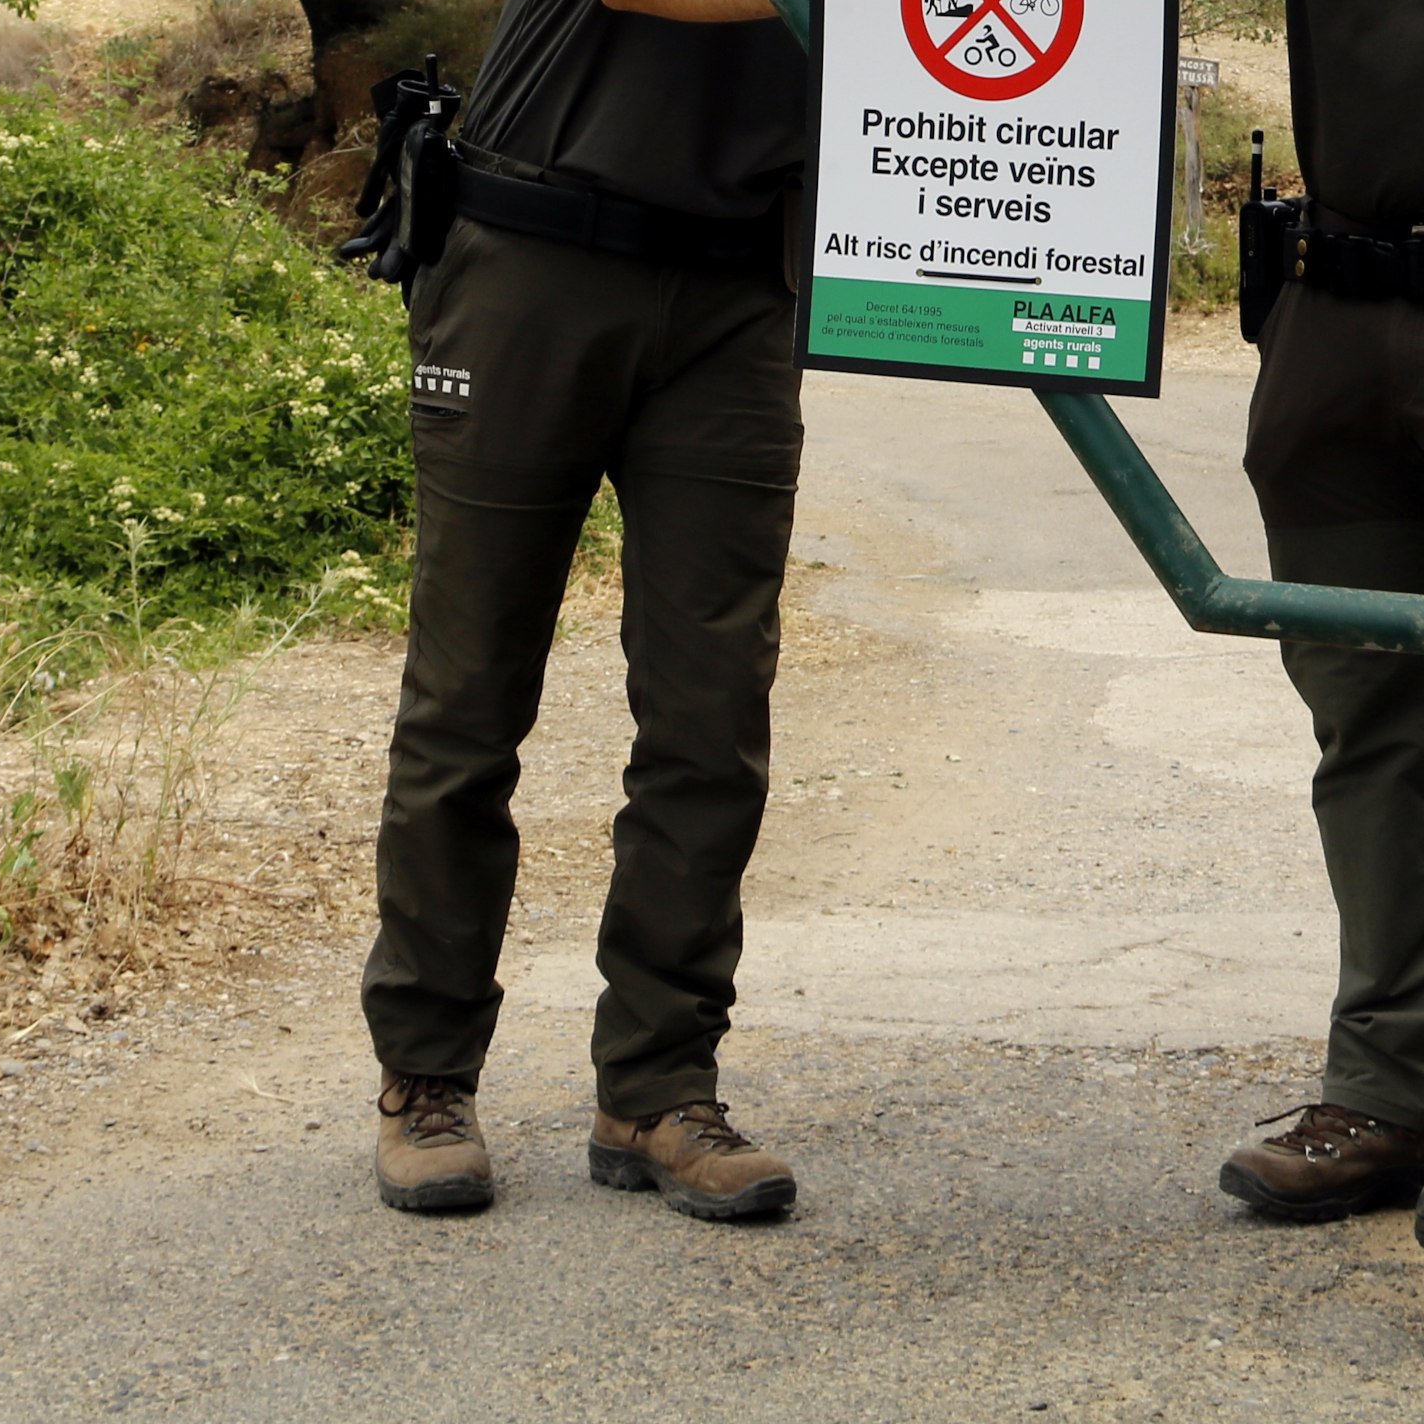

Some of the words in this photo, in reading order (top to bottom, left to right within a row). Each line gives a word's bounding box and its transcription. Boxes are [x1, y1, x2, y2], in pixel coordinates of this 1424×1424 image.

[862, 108, 987, 143] Prohibit
[996, 117, 1120, 150] circular
[871, 147, 999, 187] Excepte
[1008, 156, 1096, 188] veïns
[918, 187, 926, 215] i
[935, 194, 1052, 224] serveis
[824, 232, 859, 257] Alt
[866, 236, 912, 261] risc
[1045, 248, 1145, 277] forestal
[866, 301, 899, 314] Decret
[901, 304, 942, 317] 64/1995
[1013, 300, 1054, 321] PLA
[1059, 304, 1116, 326] ALFA
[827, 312, 842, 323] pel
[845, 314, 866, 325] qual
[936, 322, 980, 334] mesures
[1025, 321, 1062, 333] Activat
[1065, 325, 1094, 335] nivell
[1096, 326, 1103, 336] 3
[821, 326, 834, 336] de
[836, 328, 885, 340] prevenció
[940, 335, 984, 348] forestals
[1023, 338, 1064, 350] agents
[1067, 341, 1102, 353] rurals
[442, 367, 471, 381] rurals
